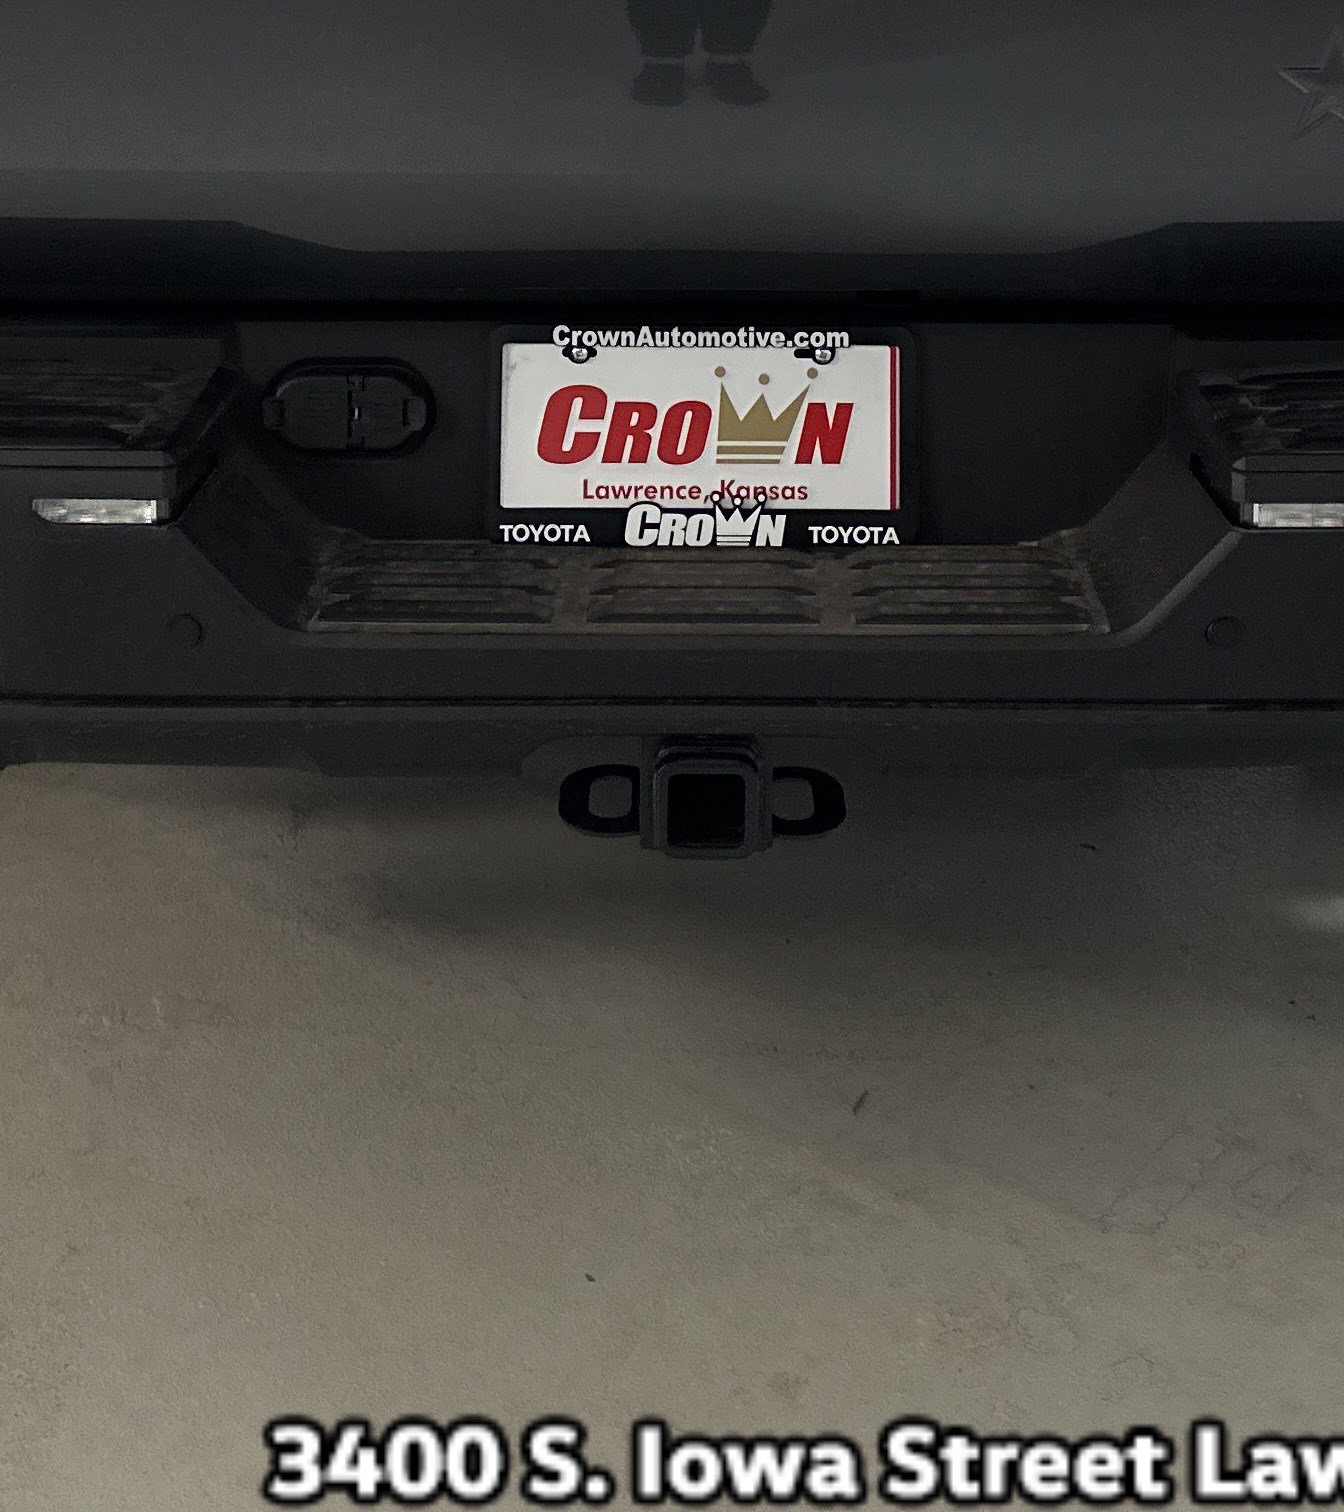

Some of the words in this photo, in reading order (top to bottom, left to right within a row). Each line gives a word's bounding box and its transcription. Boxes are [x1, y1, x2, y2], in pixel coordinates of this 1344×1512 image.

[552, 325, 850, 348] CrownAutomotive.com
[582, 479, 711, 503] Lawrence,
[720, 479, 809, 501] Kansas
[499, 524, 591, 544] TOYOTA
[808, 526, 900, 545] TOYOTA
